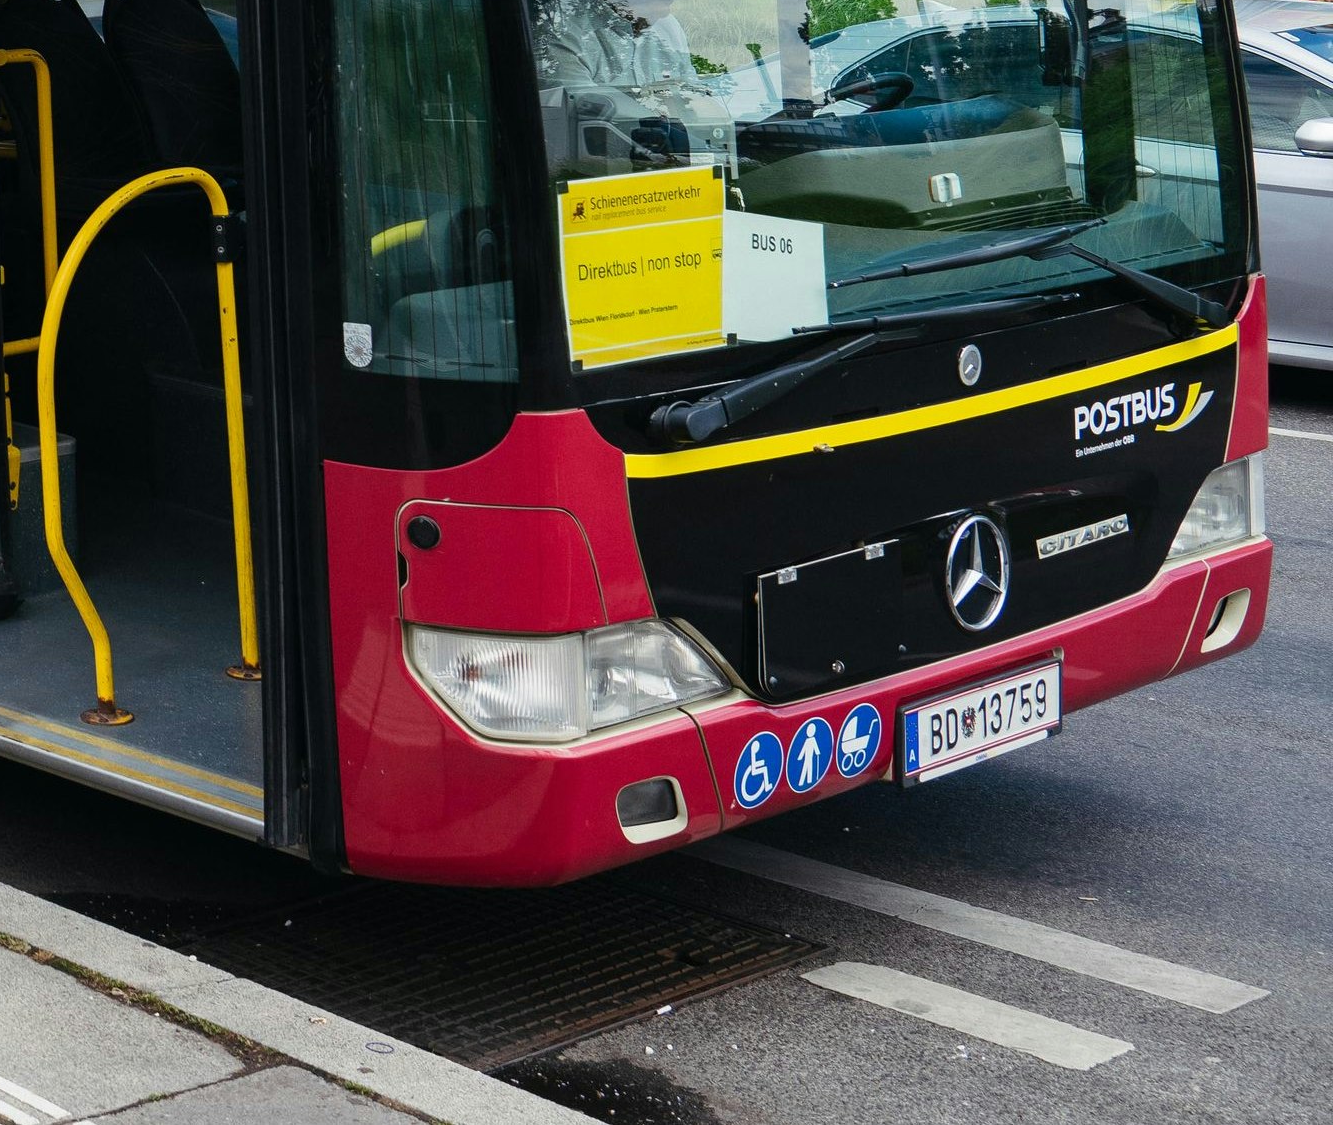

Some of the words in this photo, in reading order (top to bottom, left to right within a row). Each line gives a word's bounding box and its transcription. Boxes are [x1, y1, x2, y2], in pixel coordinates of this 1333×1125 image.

[590, 186, 701, 211] Schienenersatzverkehr
[591, 212, 600, 221] rail
[601, 208, 635, 221] replacement
[636, 206, 646, 216] bus
[648, 204, 666, 214] service
[751, 233, 776, 252] BUS
[780, 237, 793, 254] 06
[578, 259, 637, 281] Direktbus
[648, 255, 670, 271] non
[674, 251, 701, 271] stop
[569, 315, 594, 325] Direktbus
[595, 313, 608, 322] Wien
[609, 310, 635, 321] Floridsdorf
[638, 307, 650, 316] Wien
[650, 304, 678, 314] Praterstern
[1074, 382, 1175, 440] POSTBUS
[1075, 449, 1084, 458] Ein
[1084, 441, 1114, 456] Unternehmen
[1114, 439, 1123, 447] der
[1039, 518, 1128, 556] CITARO
[930, 707, 959, 756] BD
[978, 678, 1047, 738] 13759
[909, 748, 916, 763] A
